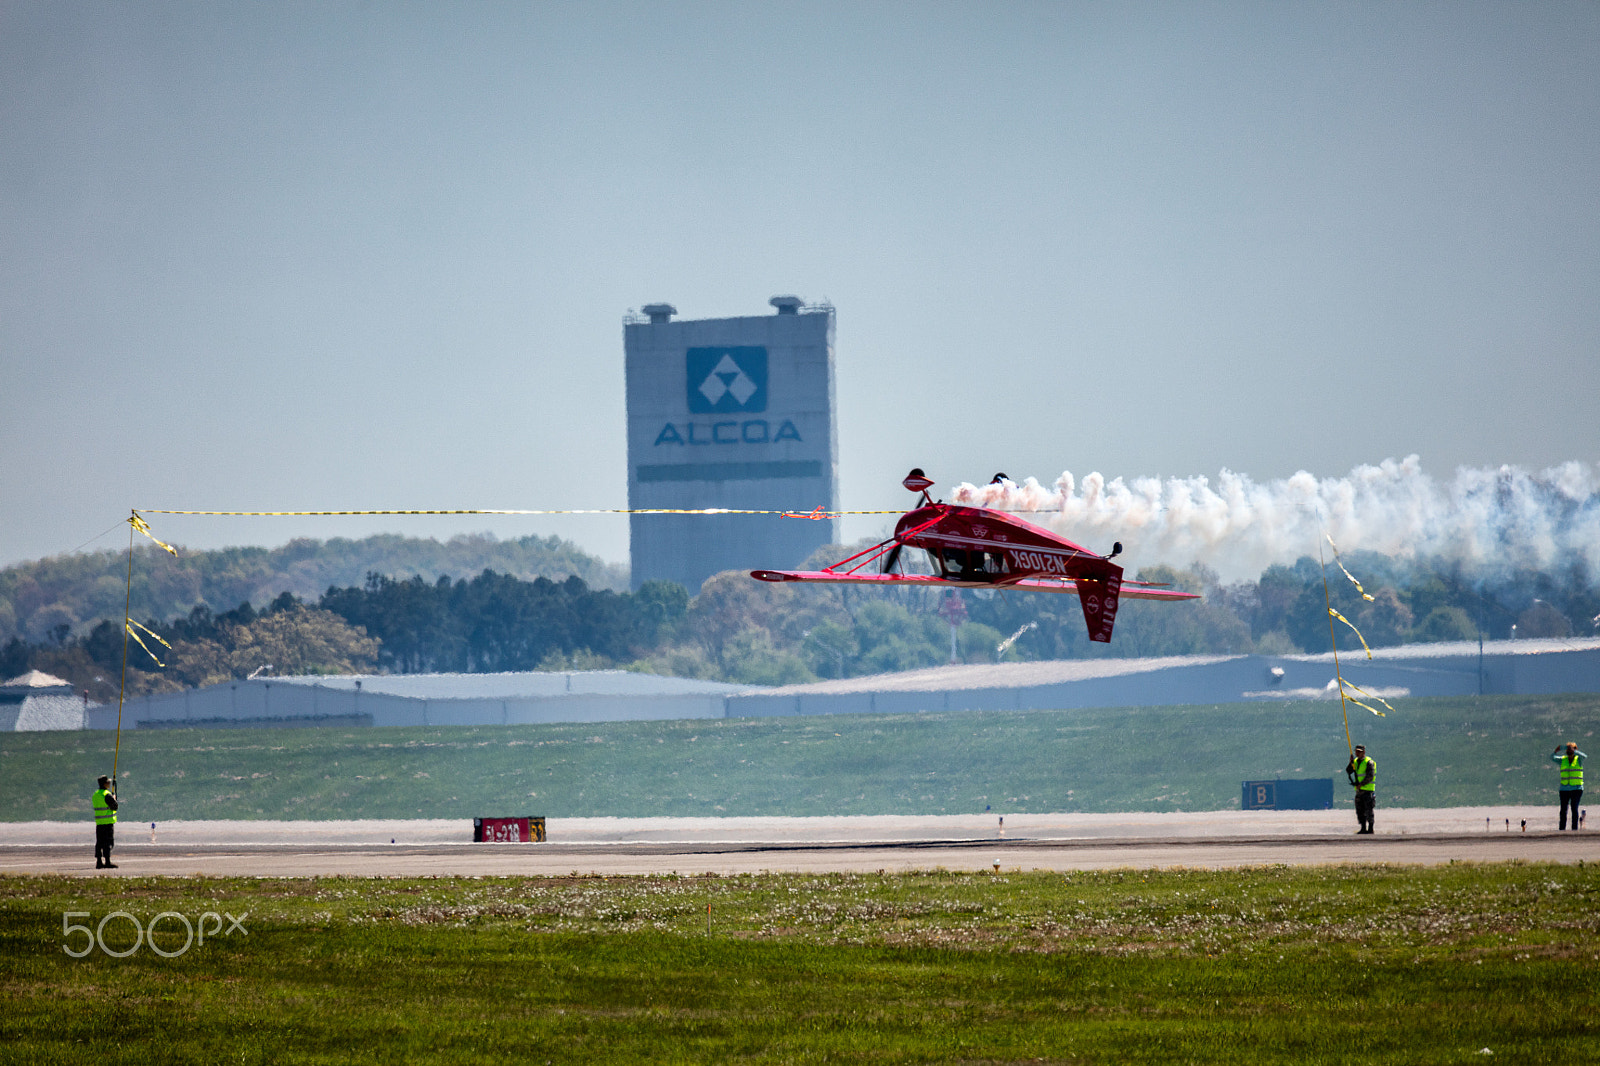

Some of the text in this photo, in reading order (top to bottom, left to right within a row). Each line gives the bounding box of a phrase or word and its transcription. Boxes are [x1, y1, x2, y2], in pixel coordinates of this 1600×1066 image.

[654, 419, 803, 446] ALCOA
[1009, 550, 1067, 574] N210GK
[1256, 786, 1267, 804] B
